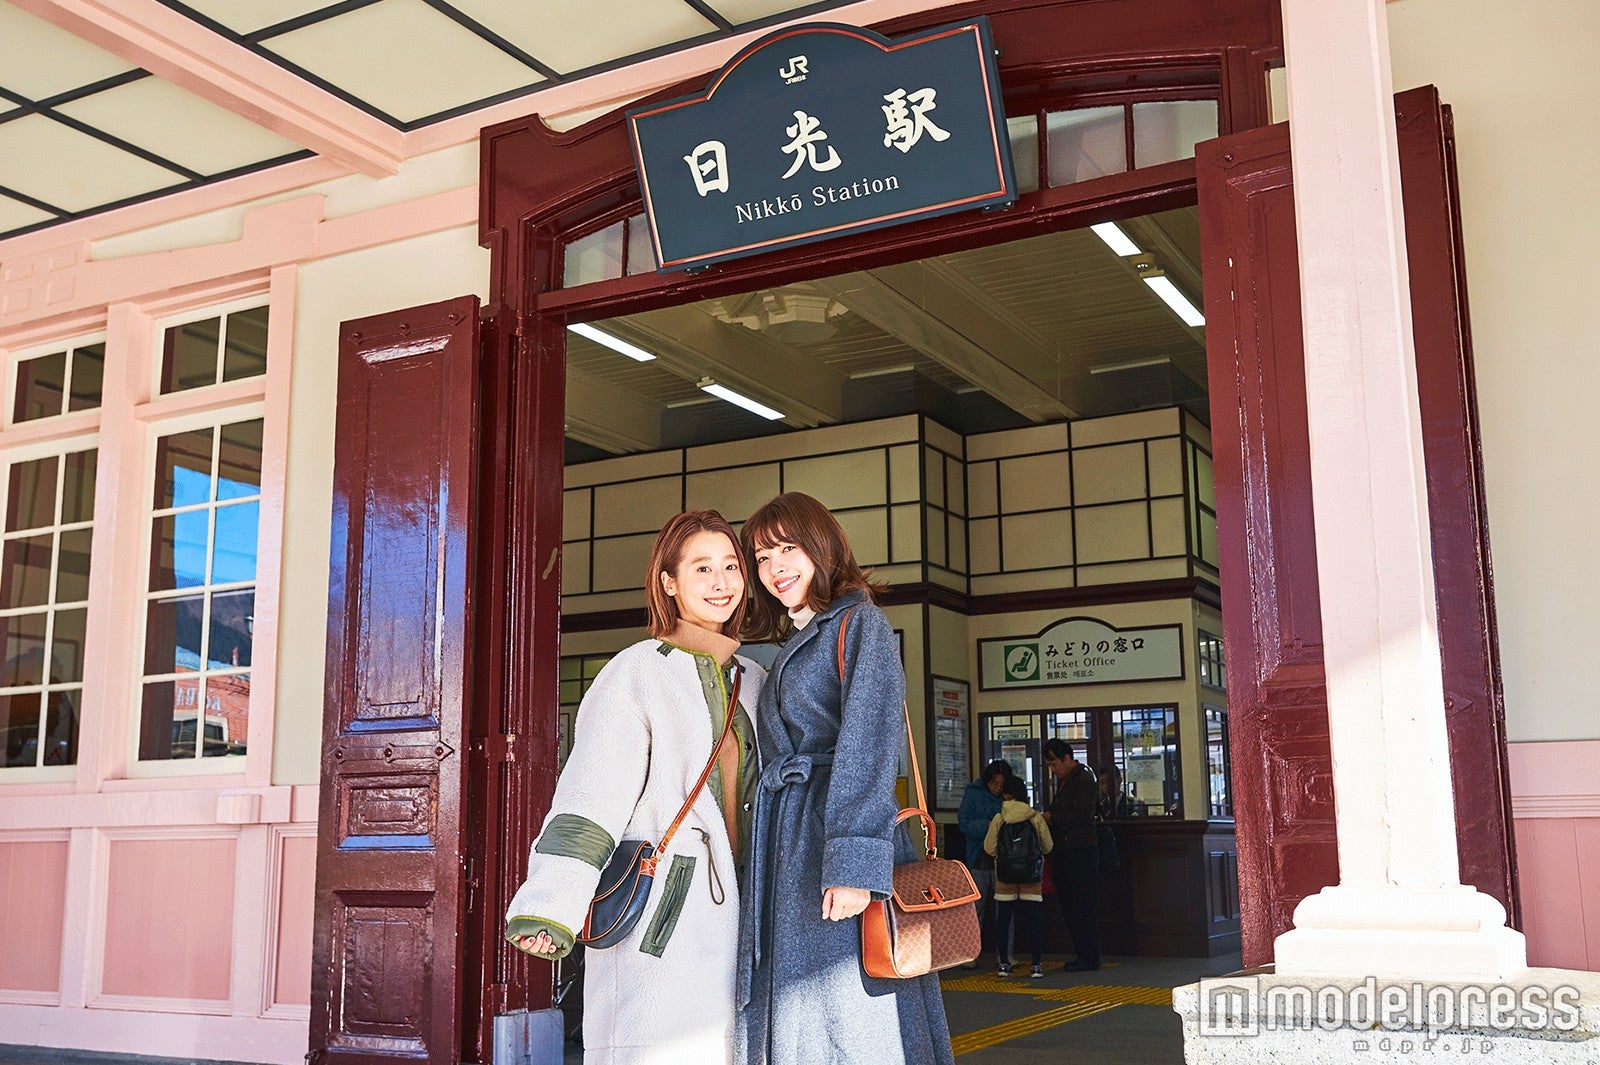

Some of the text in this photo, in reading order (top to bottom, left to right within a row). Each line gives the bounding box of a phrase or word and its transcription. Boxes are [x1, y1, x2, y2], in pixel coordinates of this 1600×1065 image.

[780, 55, 809, 79] JR
[683, 88, 951, 197] 日光駅
[735, 175, 900, 223] Nikkō Station
[1045, 637, 1144, 658] みどりの窓口
[1045, 657, 1116, 669] Ticket Office
